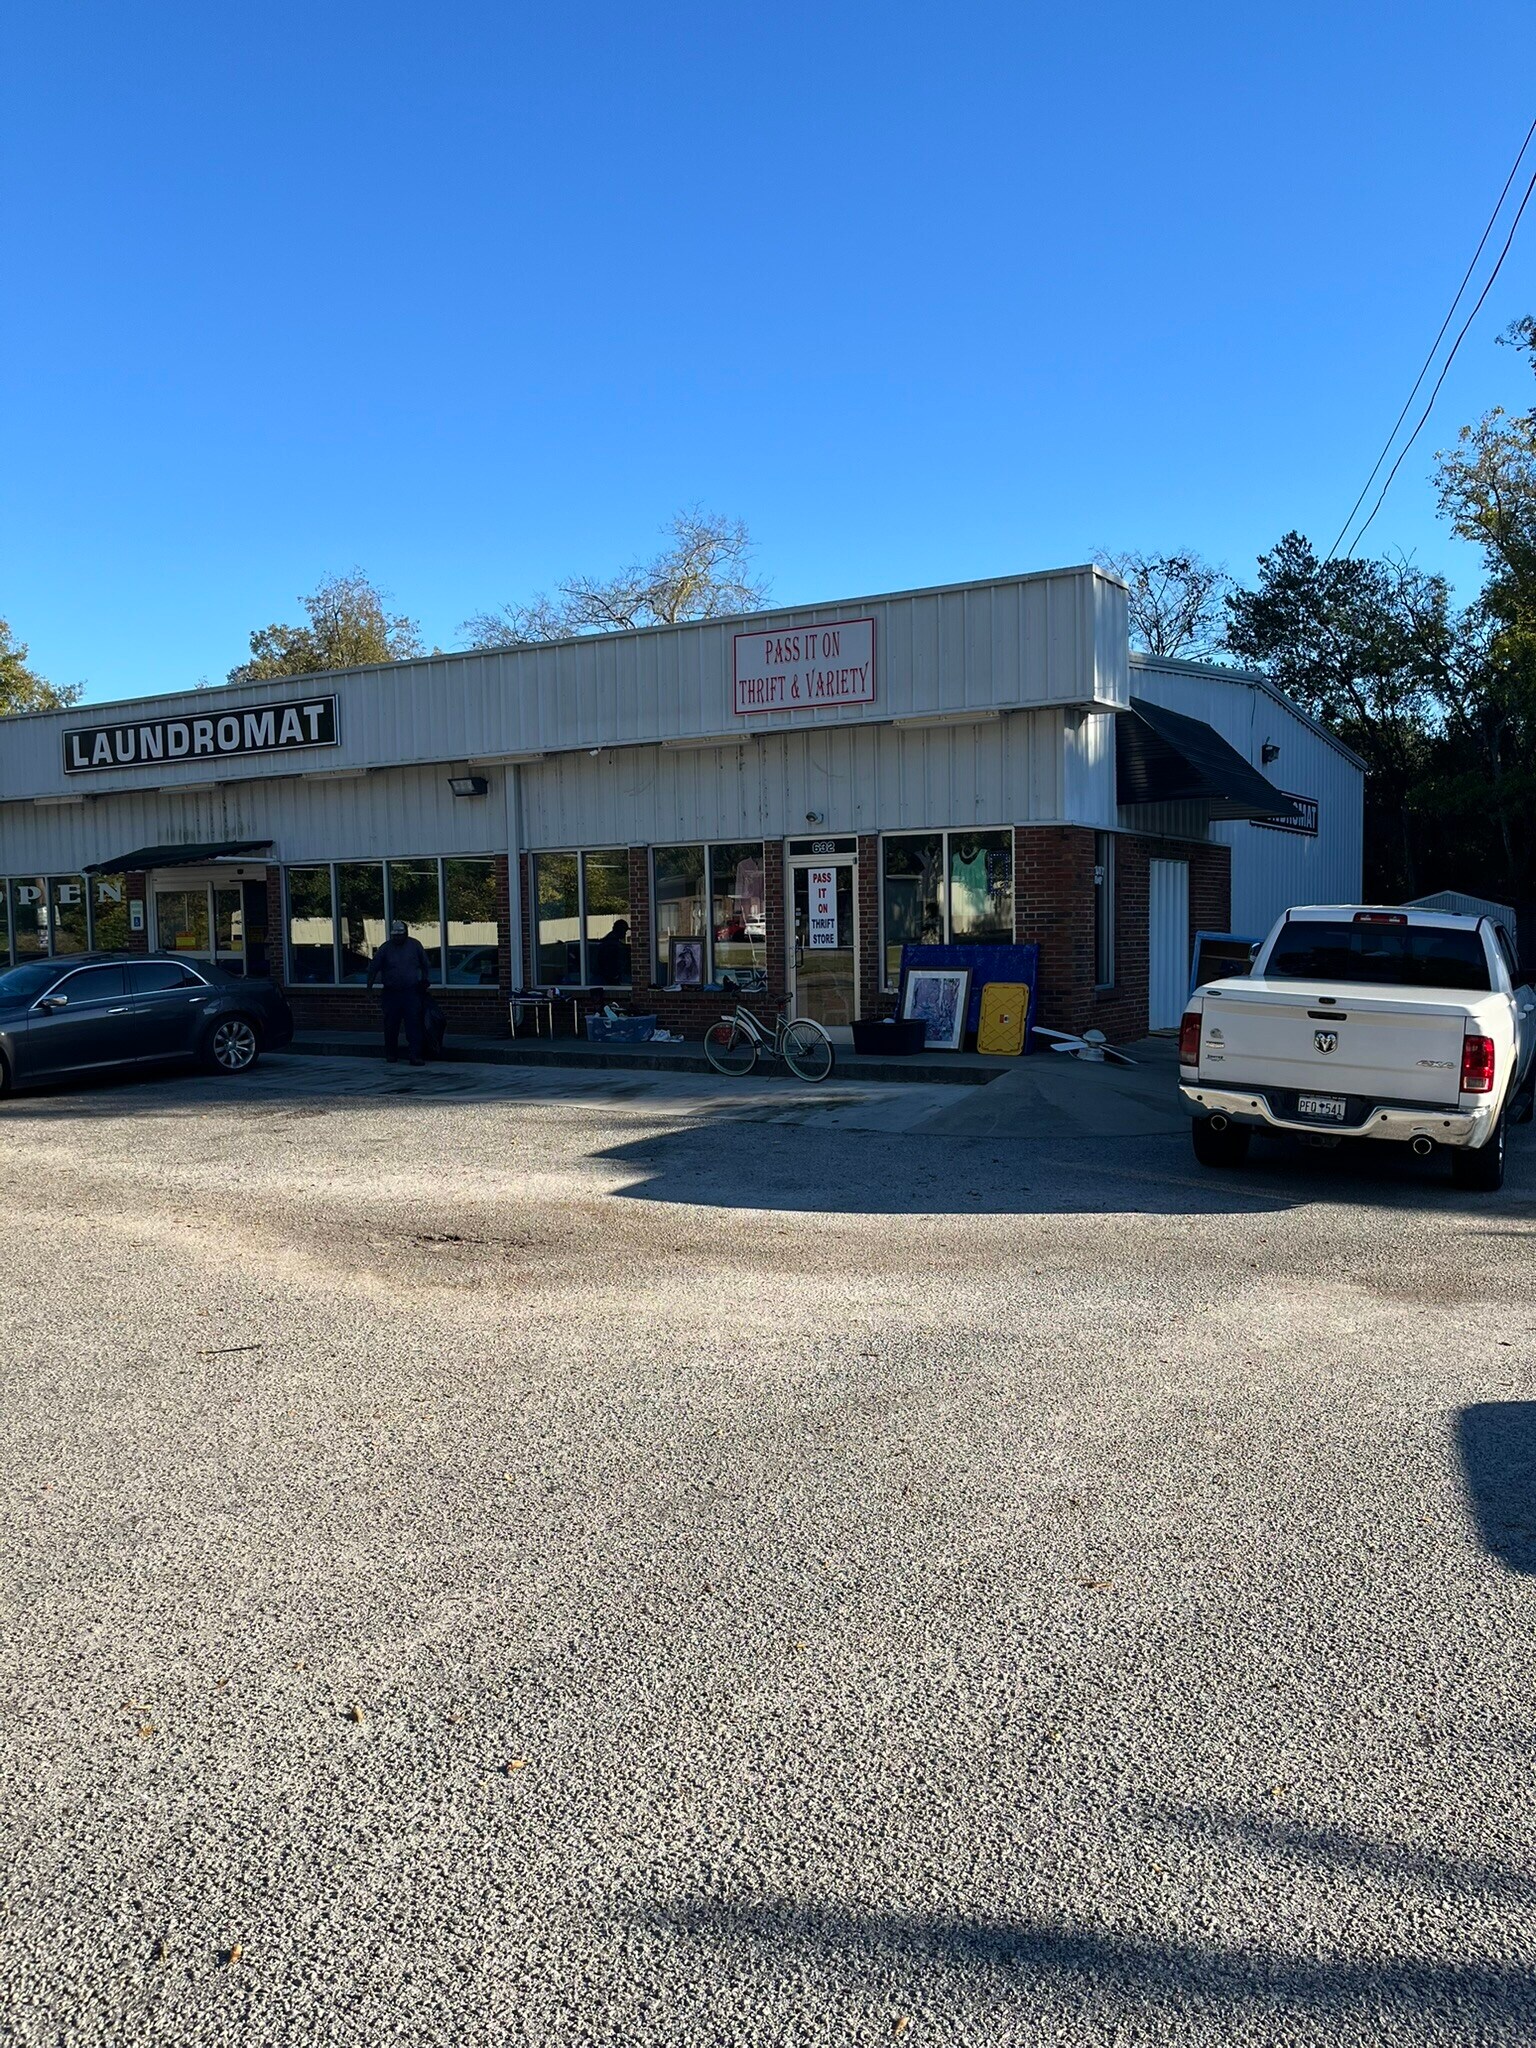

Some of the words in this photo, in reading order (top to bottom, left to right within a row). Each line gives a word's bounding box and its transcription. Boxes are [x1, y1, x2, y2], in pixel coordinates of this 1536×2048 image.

[765, 636, 801, 665] PASS
[804, 634, 818, 660] IT
[822, 631, 841, 658] ON
[738, 675, 786, 706] THRIFT
[790, 673, 801, 700] &
[805, 661, 869, 698] VARIETY
[73, 704, 324, 767] LAUNDROMAT
[811, 841, 837, 854] 632
[812, 872, 832, 884] PASS
[0, 883, 121, 905] PEN
[818, 887, 827, 899] IT
[817, 903, 828, 914] ON
[811, 918, 835, 930] THRIFT
[812, 933, 835, 945] STORE
